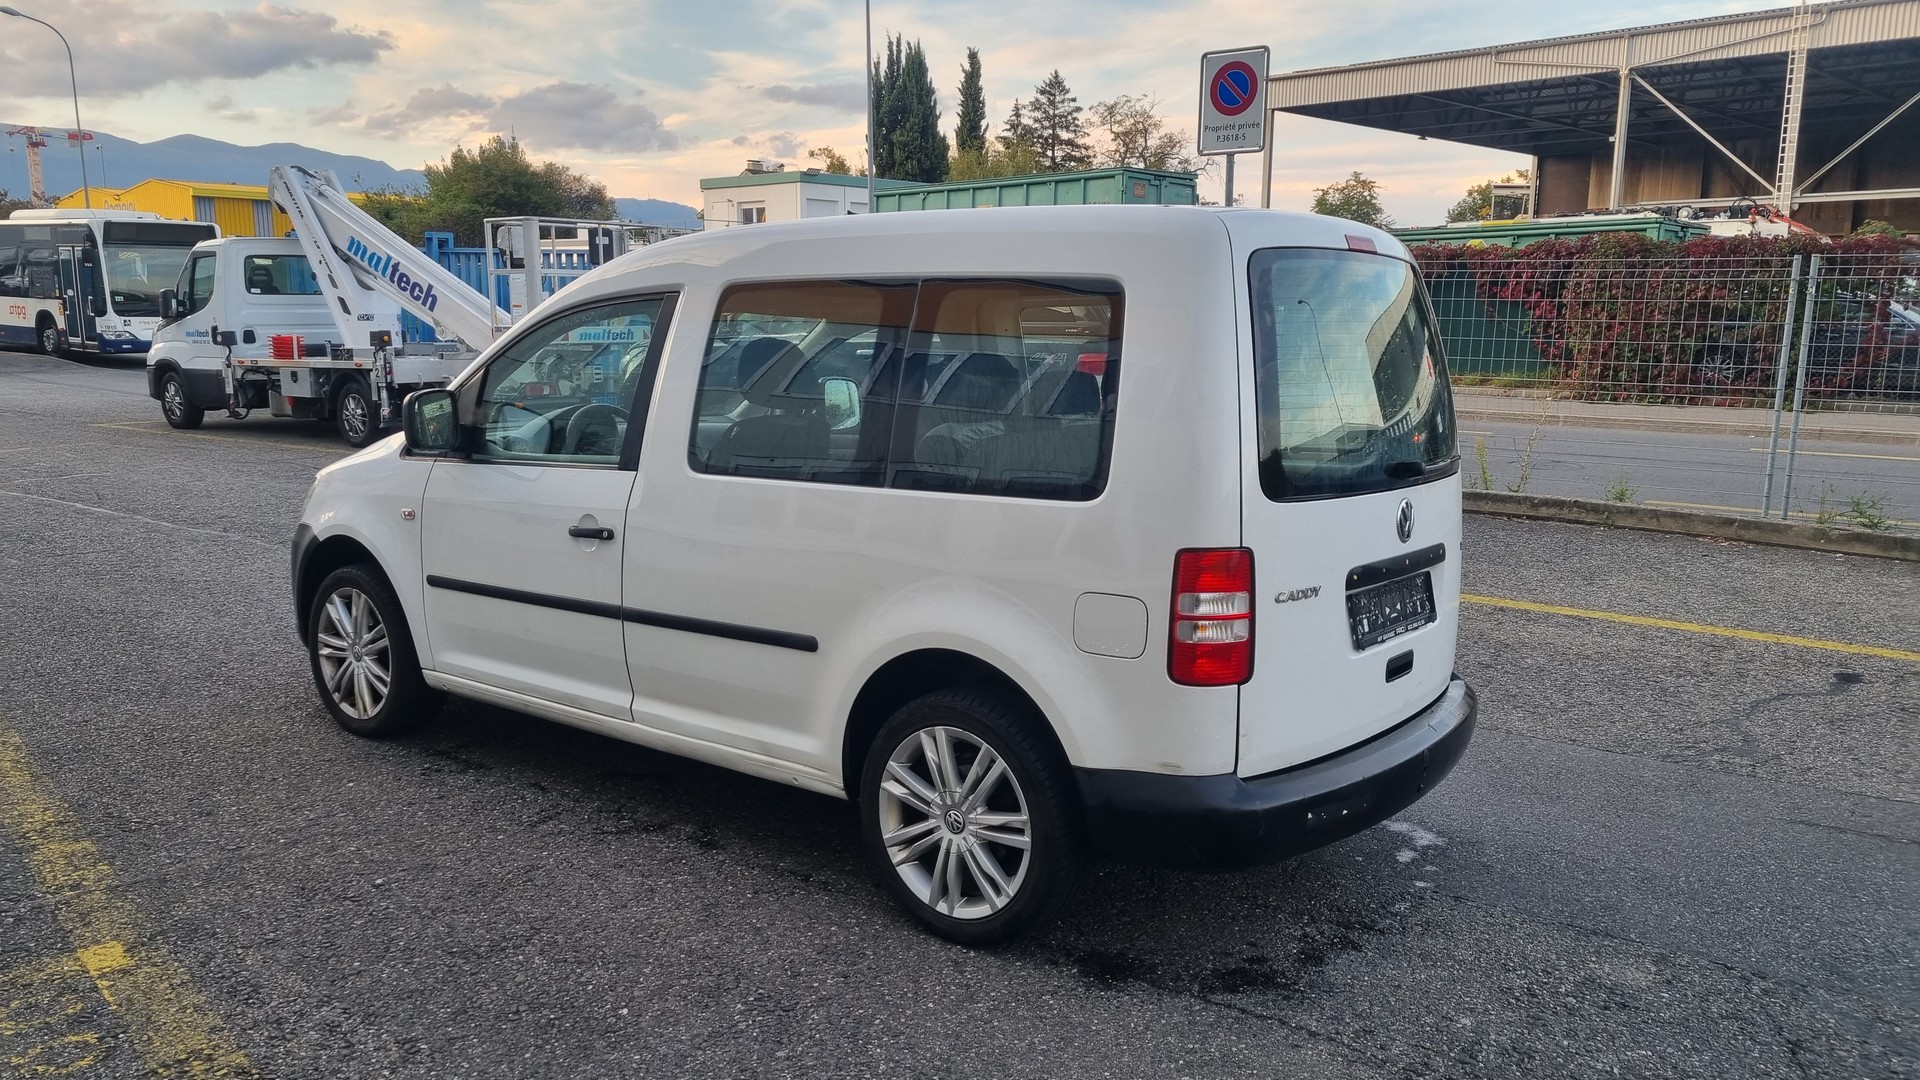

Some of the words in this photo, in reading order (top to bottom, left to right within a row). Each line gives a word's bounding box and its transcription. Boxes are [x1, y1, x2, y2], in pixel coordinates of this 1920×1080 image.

[1204, 122, 1236, 134] Propriété
[1237, 121, 1260, 131] privée
[1216, 132, 1246, 142] P.3618-5
[346, 235, 438, 313] maltech
[185, 328, 210, 338] maltech
[580, 328, 634, 340] maltech
[1274, 585, 1321, 603] CADDY
